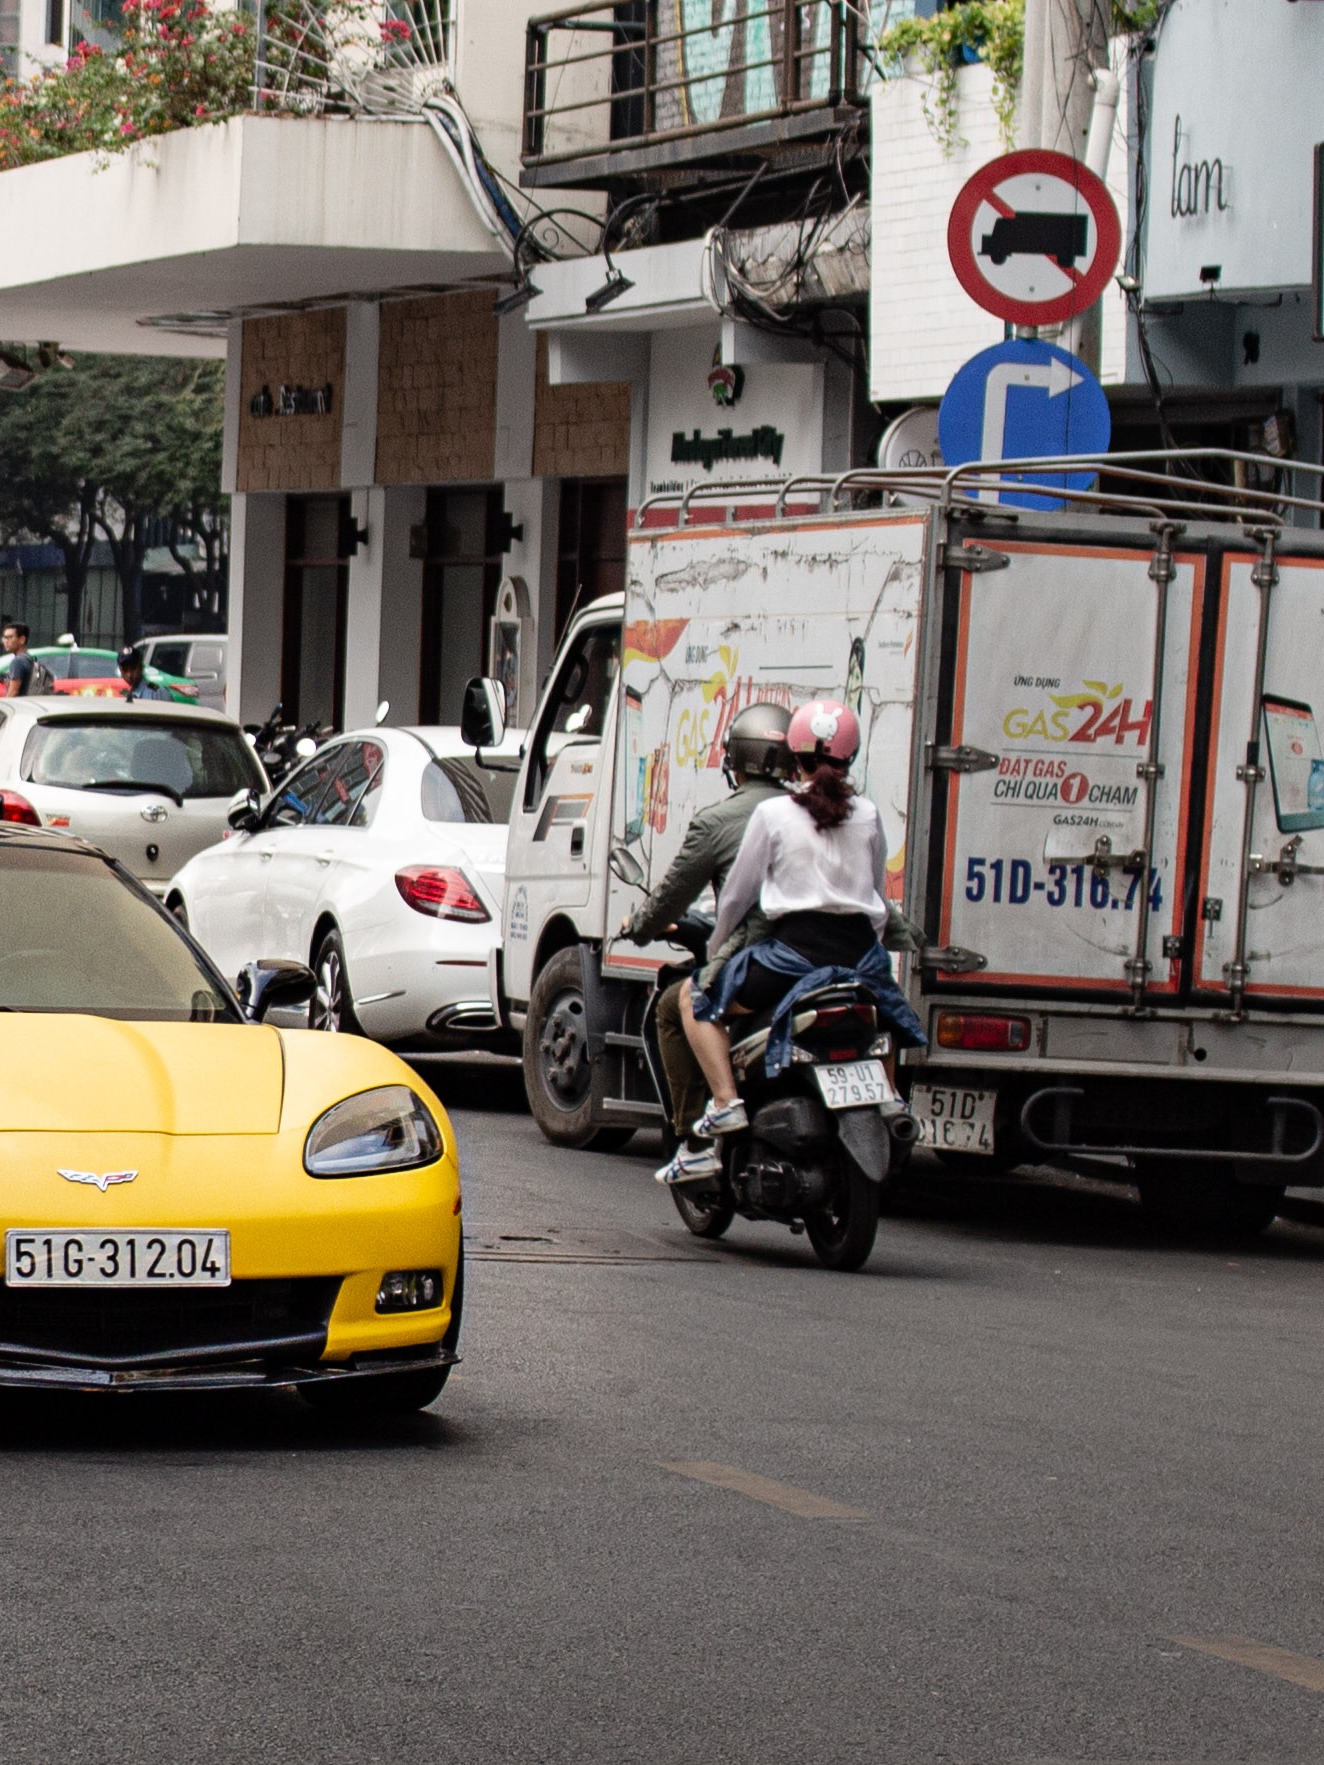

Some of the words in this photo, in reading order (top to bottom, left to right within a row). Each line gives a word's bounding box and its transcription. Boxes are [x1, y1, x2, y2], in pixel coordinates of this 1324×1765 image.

[1033, 759, 1067, 778] GAS
[1026, 781, 1059, 801] QUA
[1088, 784, 1138, 807] CHẠM
[965, 856, 1163, 912] 51D-316.74
[827, 1083, 885, 1106] 279.57
[931, 1090, 975, 1120] 51D
[15, 1238, 221, 1279] 51G-312.04
